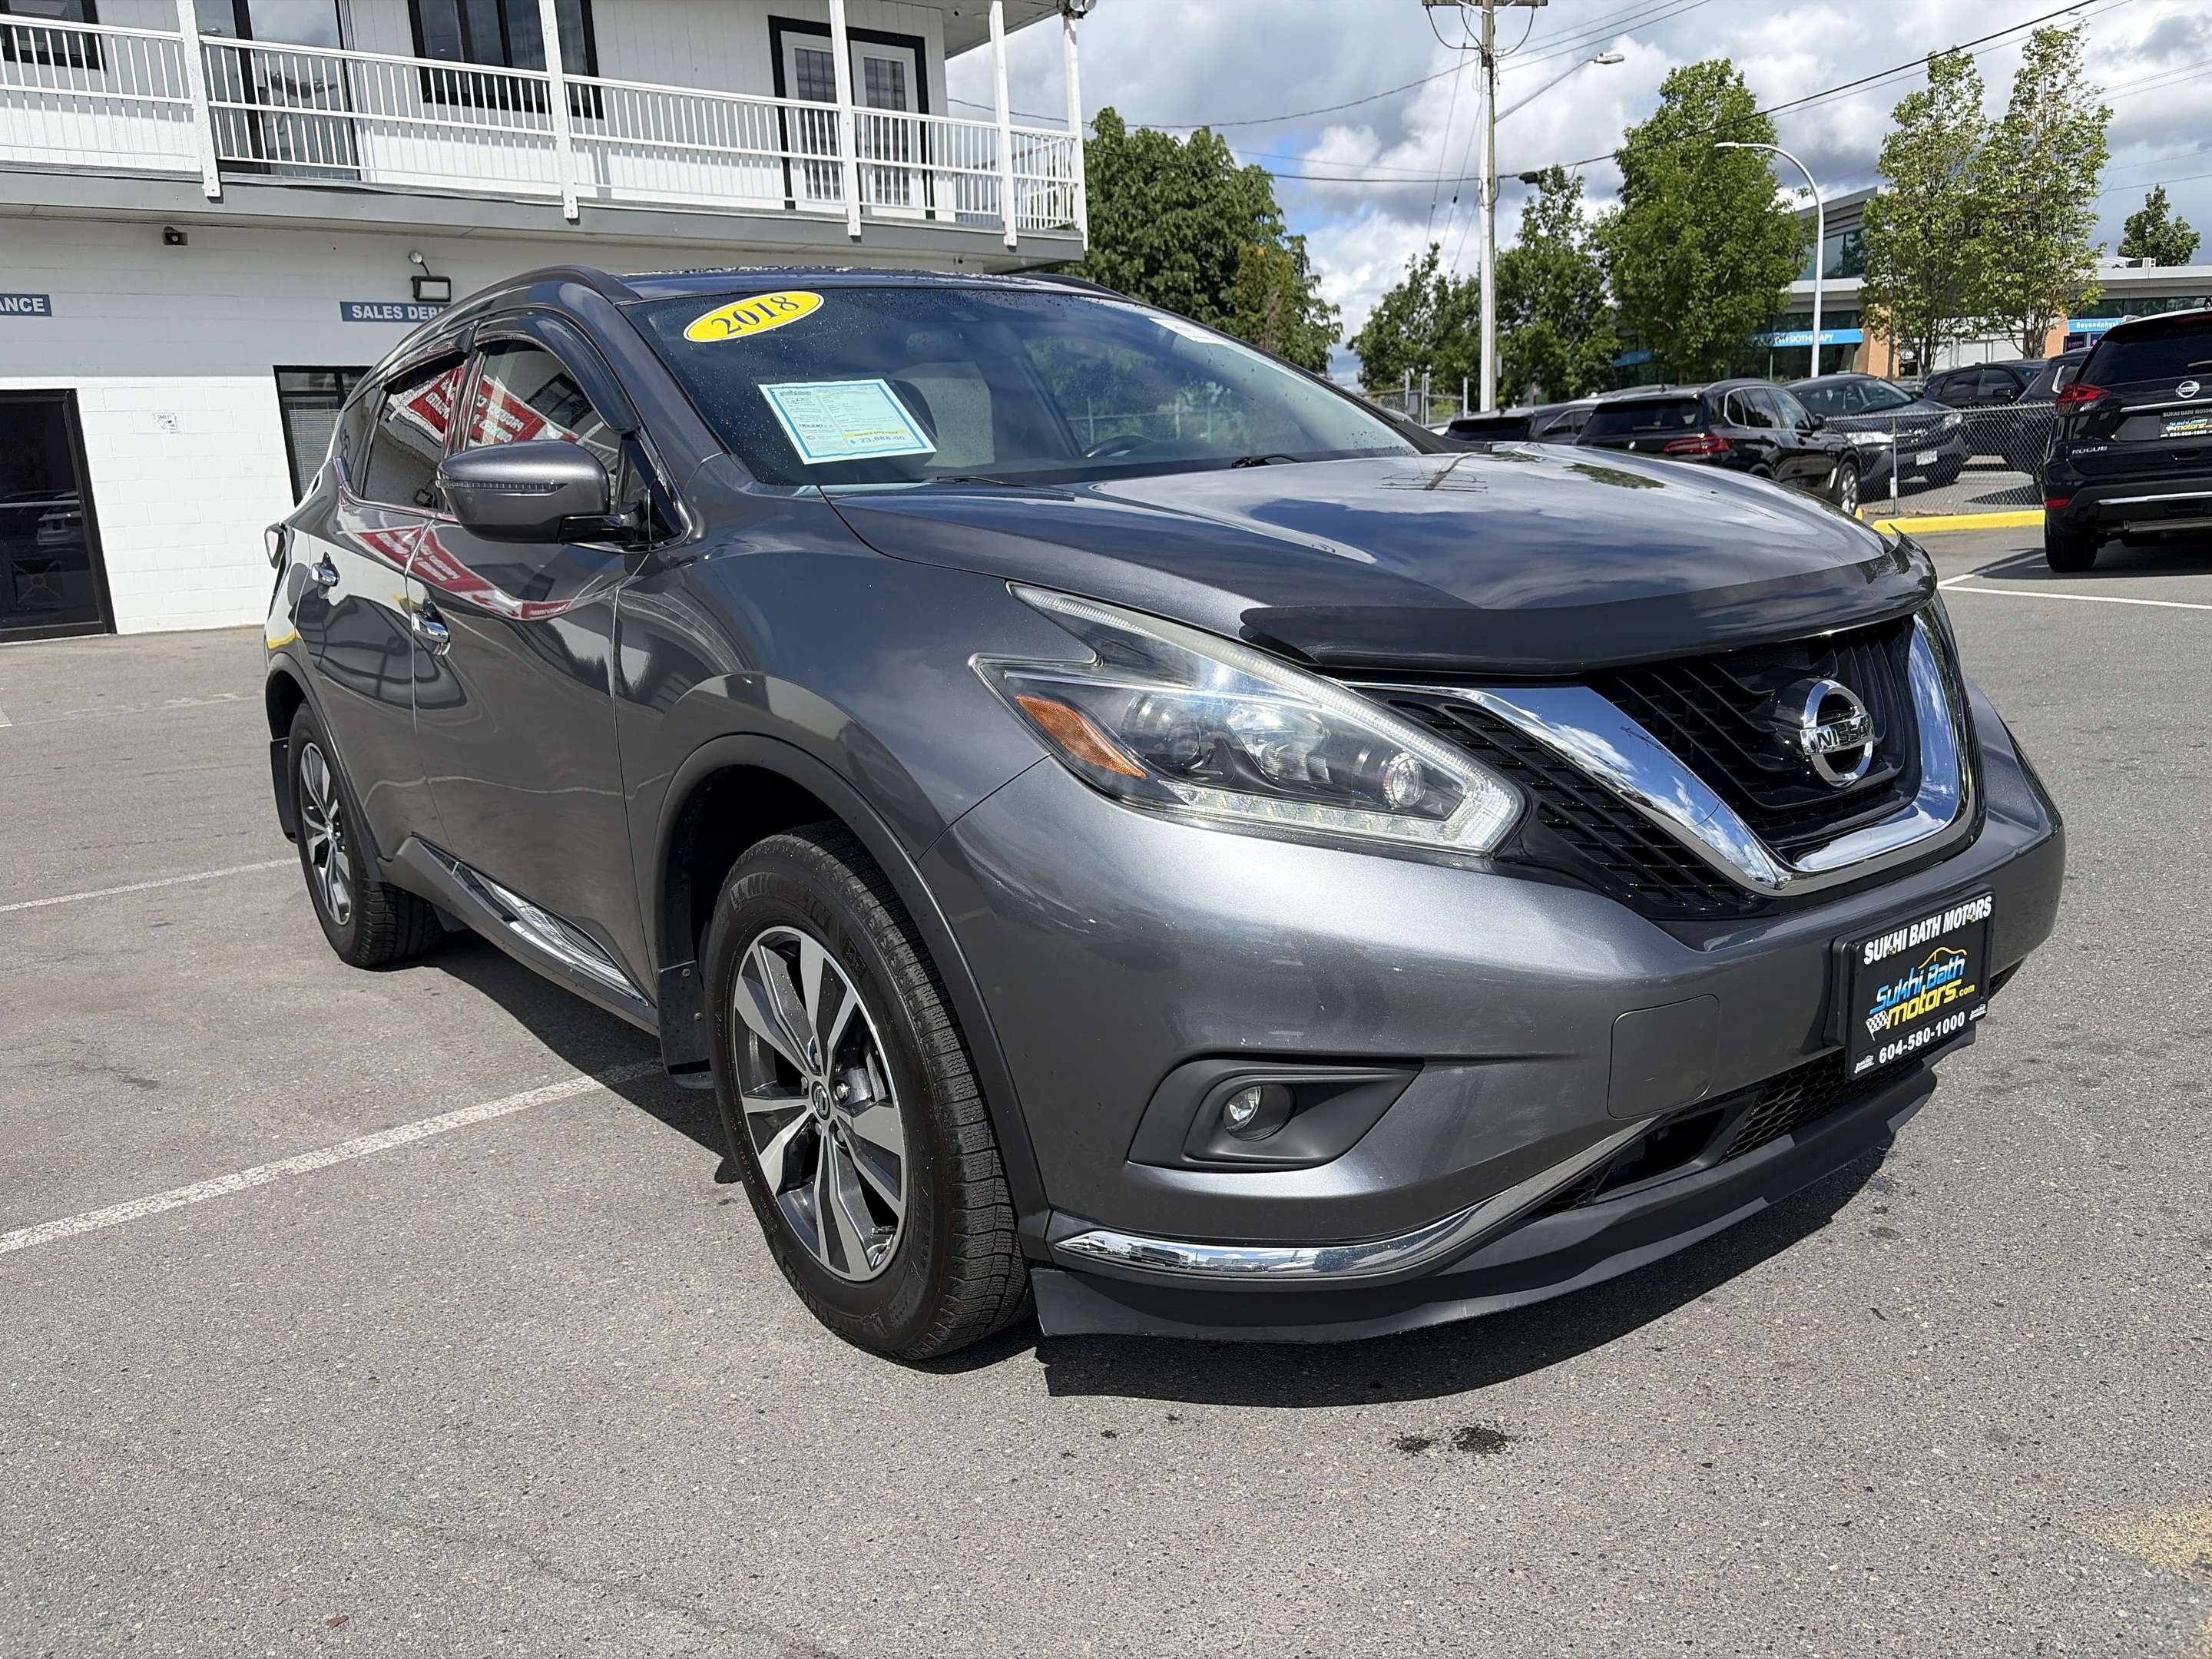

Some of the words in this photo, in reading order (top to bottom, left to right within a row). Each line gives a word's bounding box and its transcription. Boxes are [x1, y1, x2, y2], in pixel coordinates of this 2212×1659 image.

[352, 305, 402, 319] SALES
[711, 296, 799, 335] 2018
[2072, 445, 2108, 455] ROGUE
[1864, 928, 1907, 965] SUKHI
[1909, 915, 1940, 948] BATH
[1943, 896, 1992, 933] MOTORS
[1869, 965, 1924, 1014] Sukhi
[1926, 956, 1966, 989] Bath
[1879, 1011, 1965, 1063] 604-580-1000
